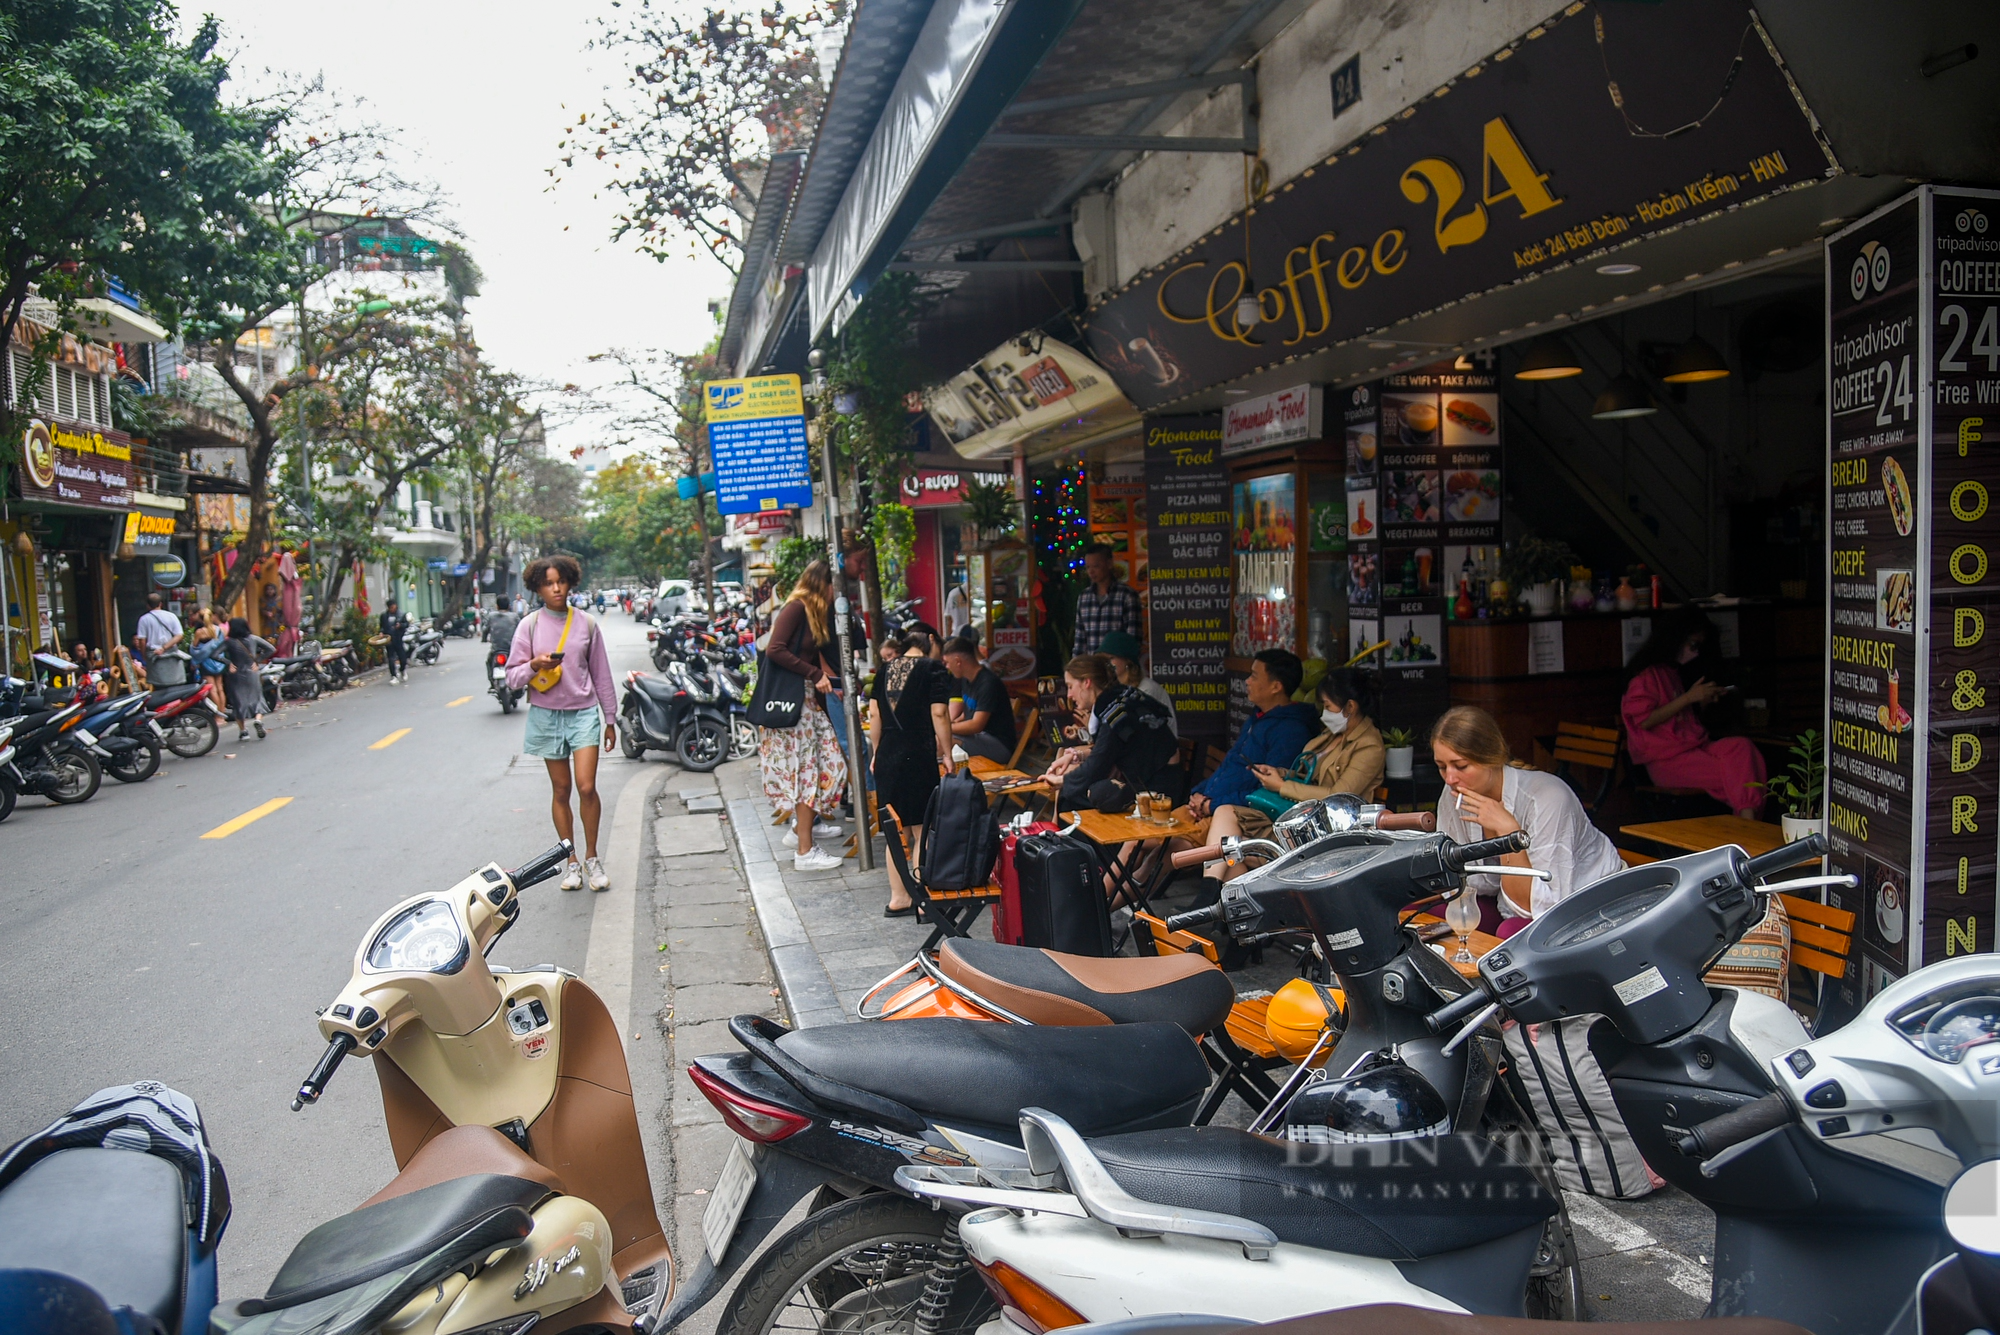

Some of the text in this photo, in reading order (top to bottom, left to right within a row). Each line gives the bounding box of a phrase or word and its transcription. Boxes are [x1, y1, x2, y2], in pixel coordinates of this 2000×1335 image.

[1545, 235, 1566, 256] 24
[1564, 224, 1591, 249] Bát
[1591, 214, 1629, 240] Đàn
[1637, 193, 1687, 223] Hoàn
[1685, 172, 1739, 205] Kiếm
[1750, 150, 1788, 183] HN
[1157, 115, 1564, 346] Coffee 24
[1939, 304, 2000, 372] 24
[1383, 375, 1496, 386] FREE WIFI TAKE AWAY
[1833, 355, 1913, 426] COFFEE 24
[1937, 379, 1970, 404] Free
[1278, 392, 1305, 422] Food
[1344, 405, 1376, 421] tripadvisor
[1839, 429, 1904, 453] FREE WIFI TAKE AWAY
[1170, 448, 1213, 466] Food
[1384, 455, 1436, 464] EGG COFFEE
[1452, 452, 1475, 464] BÁNH
[1833, 457, 1867, 487] BREAD
[1167, 493, 1221, 506] PIZZA MINI
[1834, 489, 1886, 511] BEEF, CHICKEN, PORK
[1169, 532, 1222, 544] BÁNH BAO
[1385, 527, 1495, 539] VEGETARIAN BREAKFAST
[1833, 545, 1866, 576] CREPÉ
[1151, 567, 1174, 579] BÁNH
[1176, 568, 1187, 578] SU
[1188, 567, 1207, 578] KEM
[1152, 584, 1181, 595] BÁNH
[1185, 583, 1216, 594] BÔNG
[1834, 583, 1876, 600] NUTELLA BANANA
[1152, 598, 1184, 611] CUỘN
[1188, 599, 1210, 609] KEM
[1401, 603, 1423, 612] BEER
[1175, 619, 1202, 629] BÁNH
[1834, 609, 1874, 628] JAMBON PHOMAI
[995, 632, 1029, 645] CREPE
[1165, 633, 1184, 642] PHO
[1187, 633, 1207, 641] MAI
[1198, 645, 1226, 658] CHÁY
[1832, 635, 1895, 670] BREAKFAST
[1153, 665, 1174, 675] SIÊU
[1402, 670, 1424, 679] WINE
[1834, 670, 1878, 694] OMELETTE, BACON
[1857, 703, 1876, 722] CHEESE
[1831, 718, 1898, 764] VEGETARIAN
[1833, 752, 1905, 792] SALAD, VEGETABLE SANDWICH
[1832, 778, 1846, 797] FRESH
[1830, 802, 1868, 841] DRINKS
[1831, 835, 1848, 857] COFFEE
[1830, 891, 1841, 910] BEER
